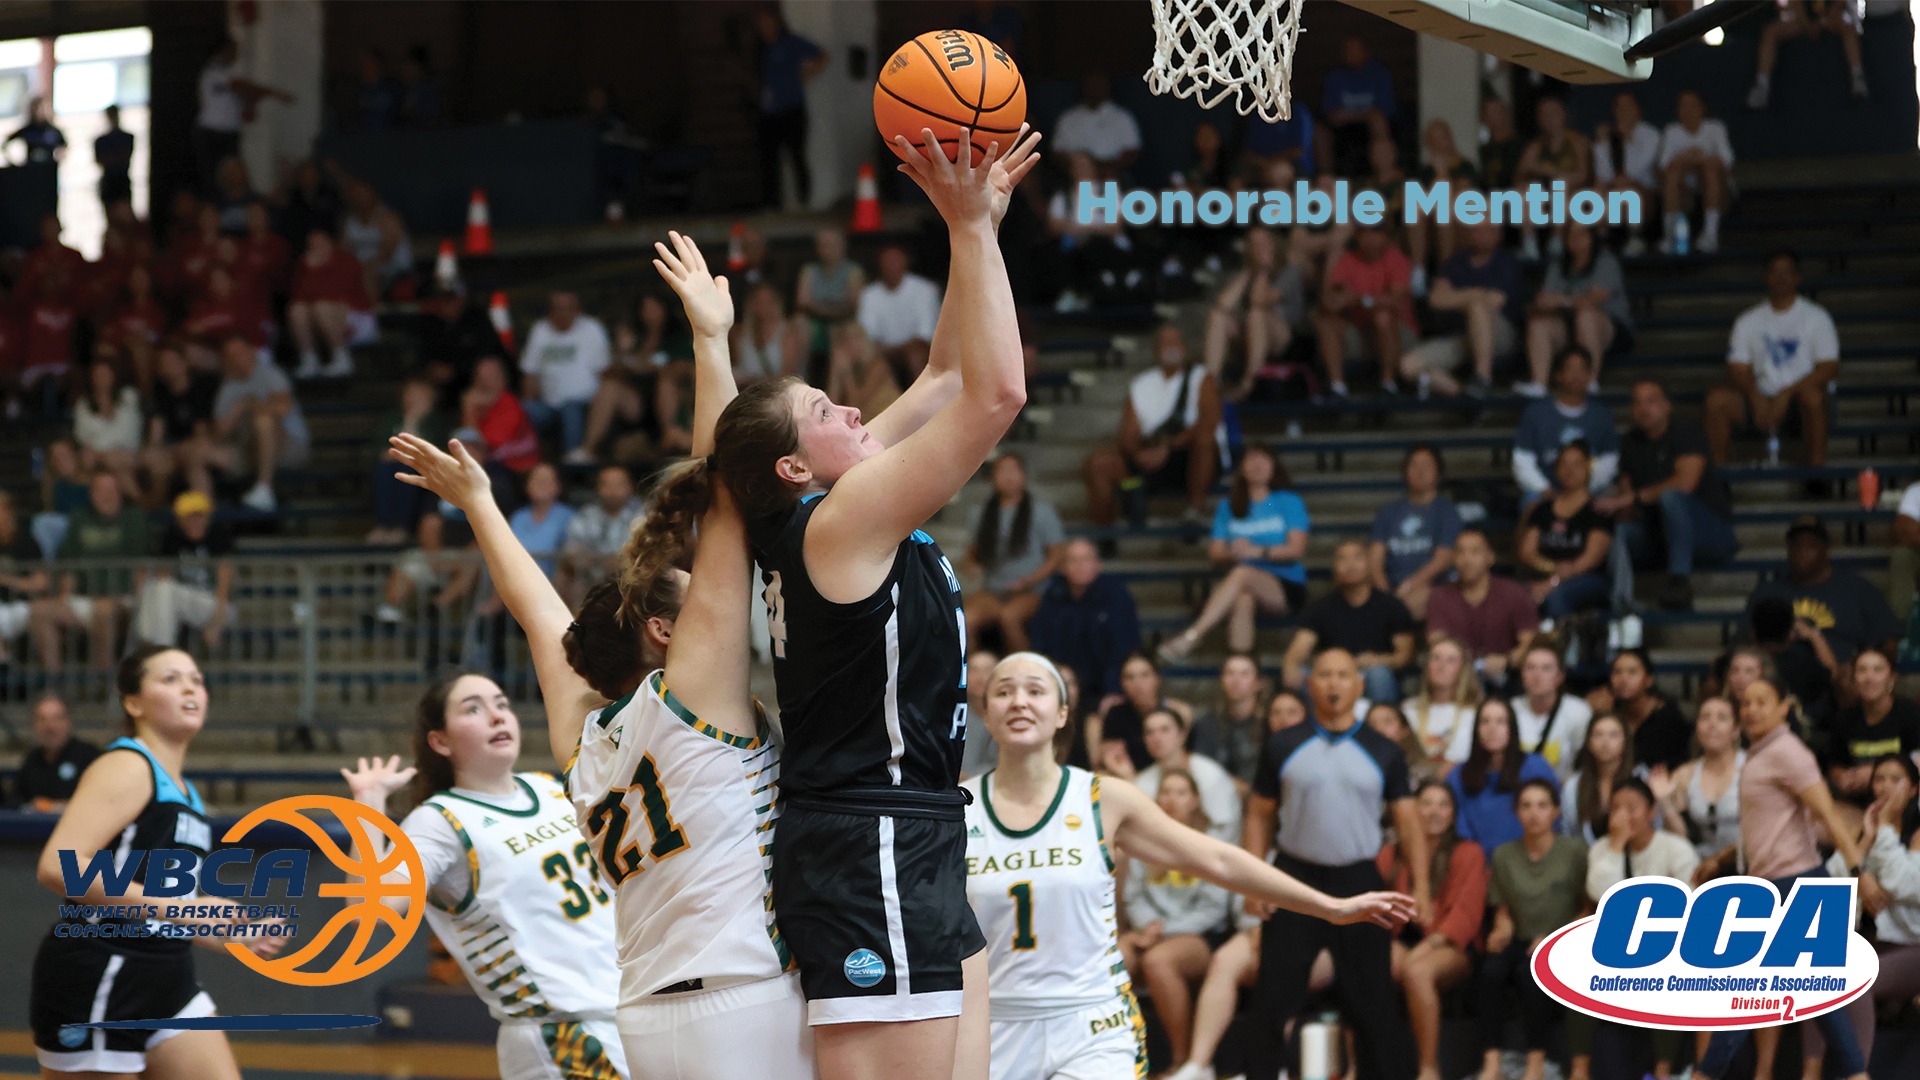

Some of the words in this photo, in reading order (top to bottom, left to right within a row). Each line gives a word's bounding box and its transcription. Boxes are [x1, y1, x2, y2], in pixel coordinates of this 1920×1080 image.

[504, 814, 579, 855] EAGLE
[587, 750, 691, 886] 21
[965, 848, 1083, 876] EAGLES
[1008, 880, 1038, 952] 1
